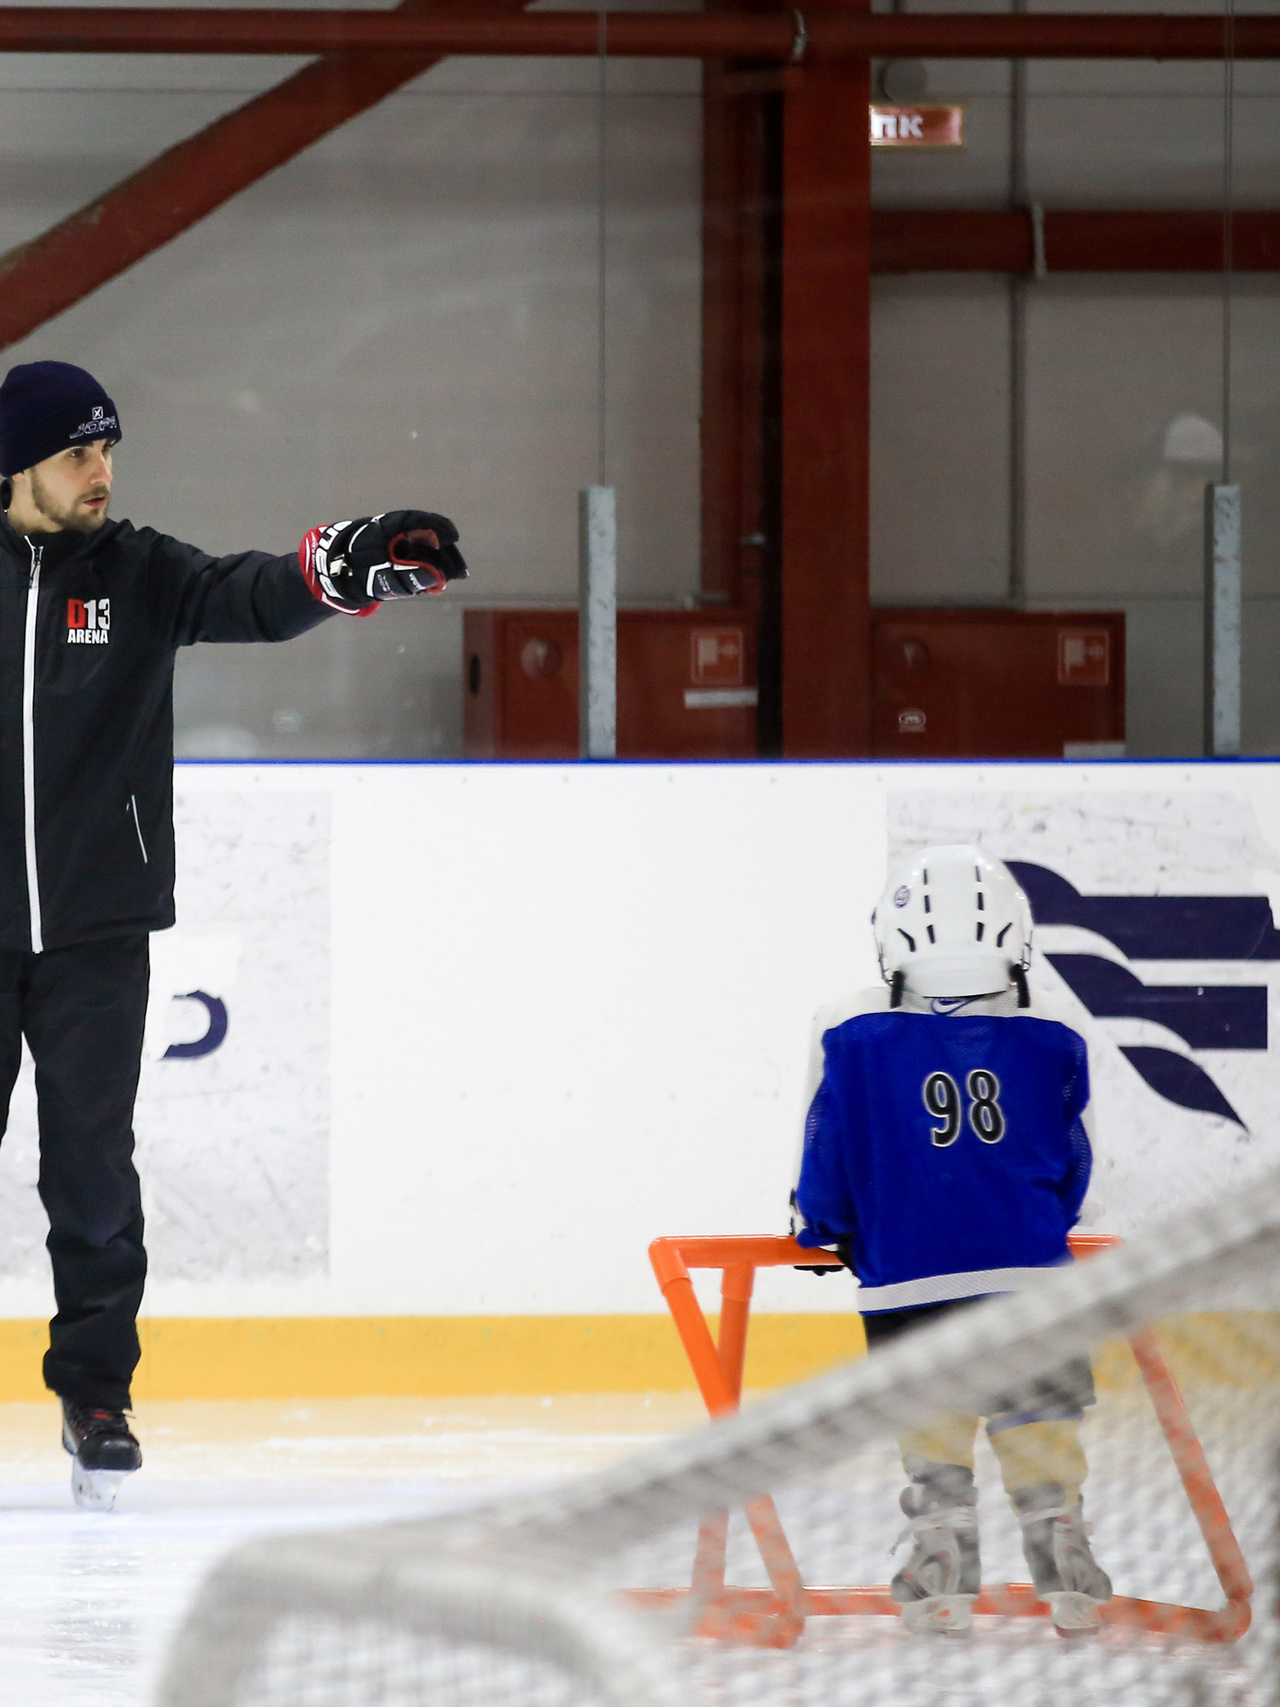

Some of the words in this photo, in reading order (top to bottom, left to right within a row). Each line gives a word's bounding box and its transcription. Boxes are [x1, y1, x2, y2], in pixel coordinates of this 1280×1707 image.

[67, 598, 110, 630] D13
[67, 629, 109, 644] ARENA
[922, 1069, 1006, 1148] 98
